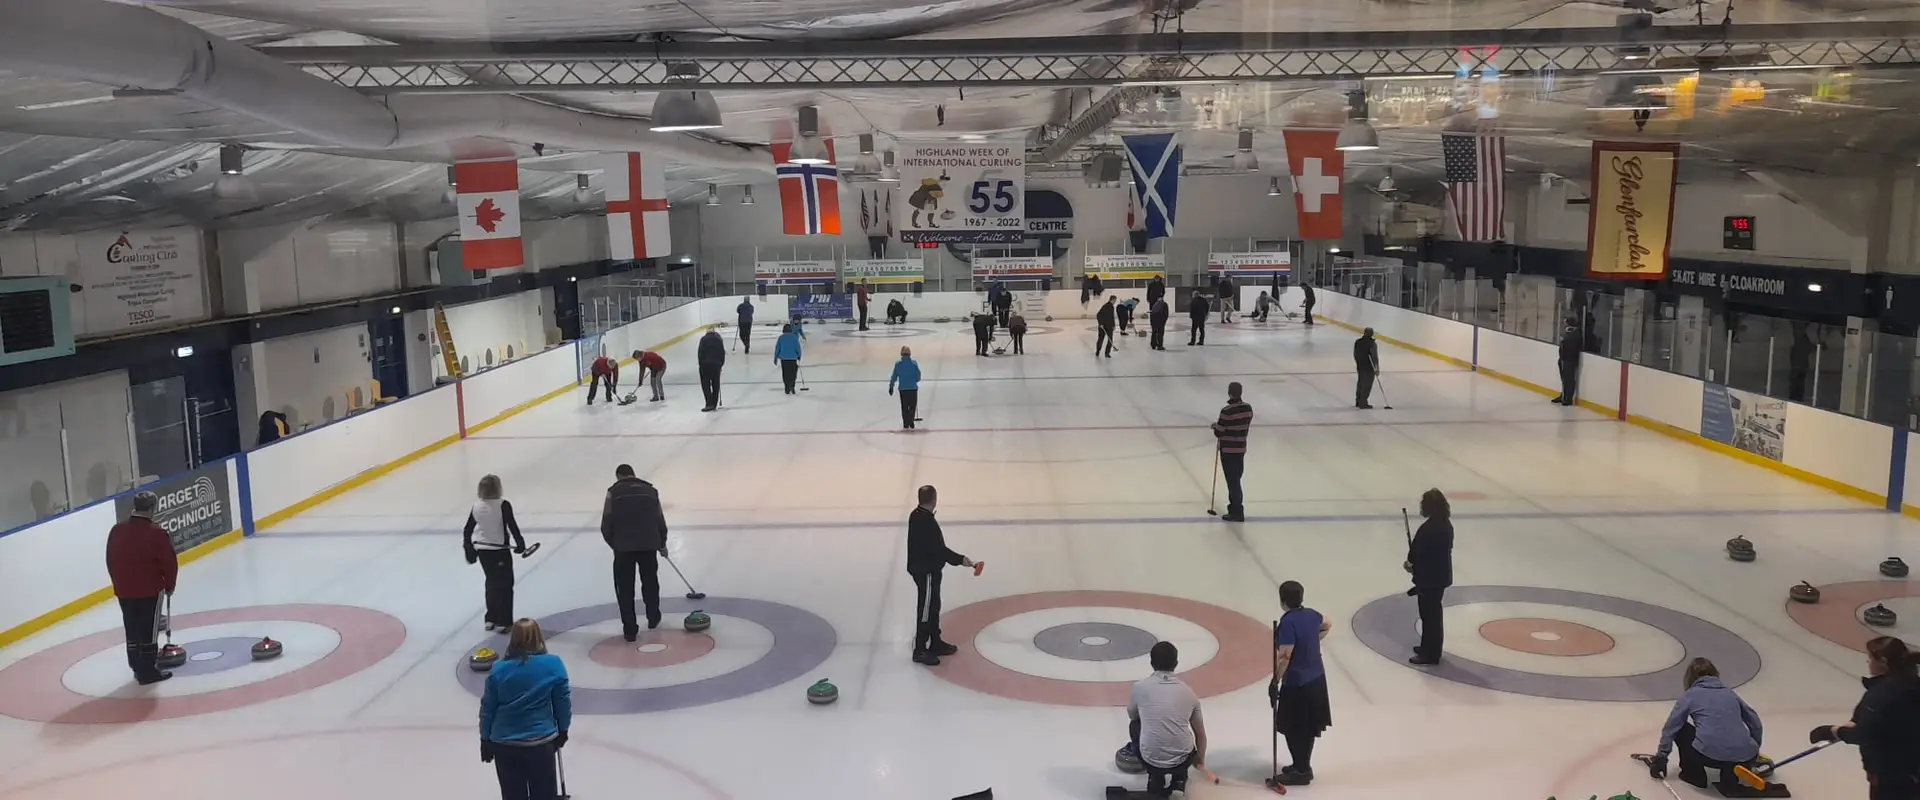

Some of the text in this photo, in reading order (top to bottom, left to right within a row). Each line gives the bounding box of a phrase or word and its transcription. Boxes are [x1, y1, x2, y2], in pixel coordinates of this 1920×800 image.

[916, 148, 1010, 157] HIGHLAND WEEK OF
[903, 158, 1022, 167] INTERNATIONAL CURLING
[969, 180, 1014, 214] 55
[1611, 155, 1651, 270] Glenfarclas
[964, 218, 986, 227] 1967
[997, 218, 1020, 227] 2022
[1029, 221, 1068, 231] CENTRE
[918, 231, 963, 242] Welcome
[1672, 269, 1785, 295] SKATE HIRE & CLOAKROOM
[127, 309, 154, 320] TESCO
[158, 483, 200, 512] ARGET
[160, 500, 222, 534] ECHNIQUE
